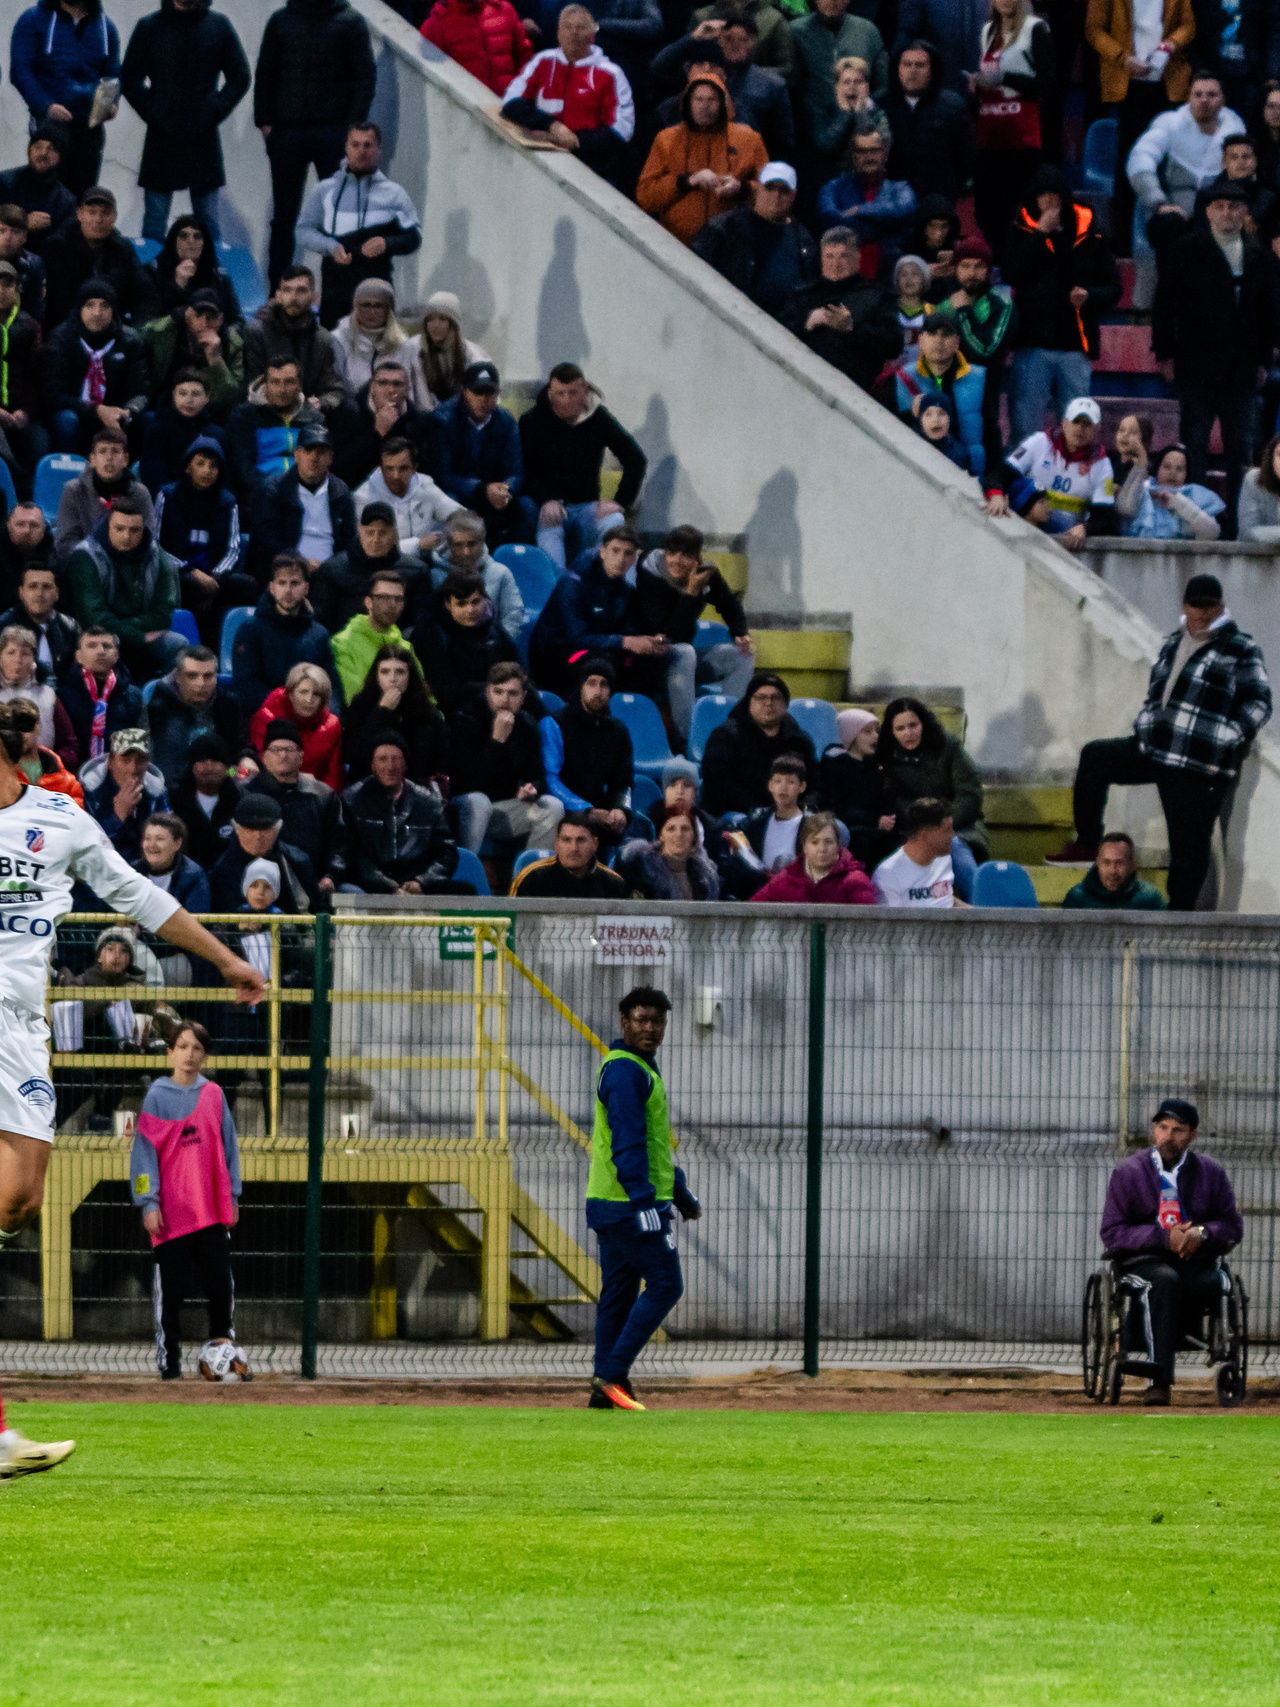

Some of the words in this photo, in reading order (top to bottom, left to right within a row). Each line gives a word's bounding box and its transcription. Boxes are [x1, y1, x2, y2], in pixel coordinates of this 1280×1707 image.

[1051, 475, 1072, 493] 80
[599, 925, 659, 940] TRIBUNA
[662, 926, 670, 940] 2
[602, 944, 653, 957] SECTOR
[657, 944, 666, 957] A
